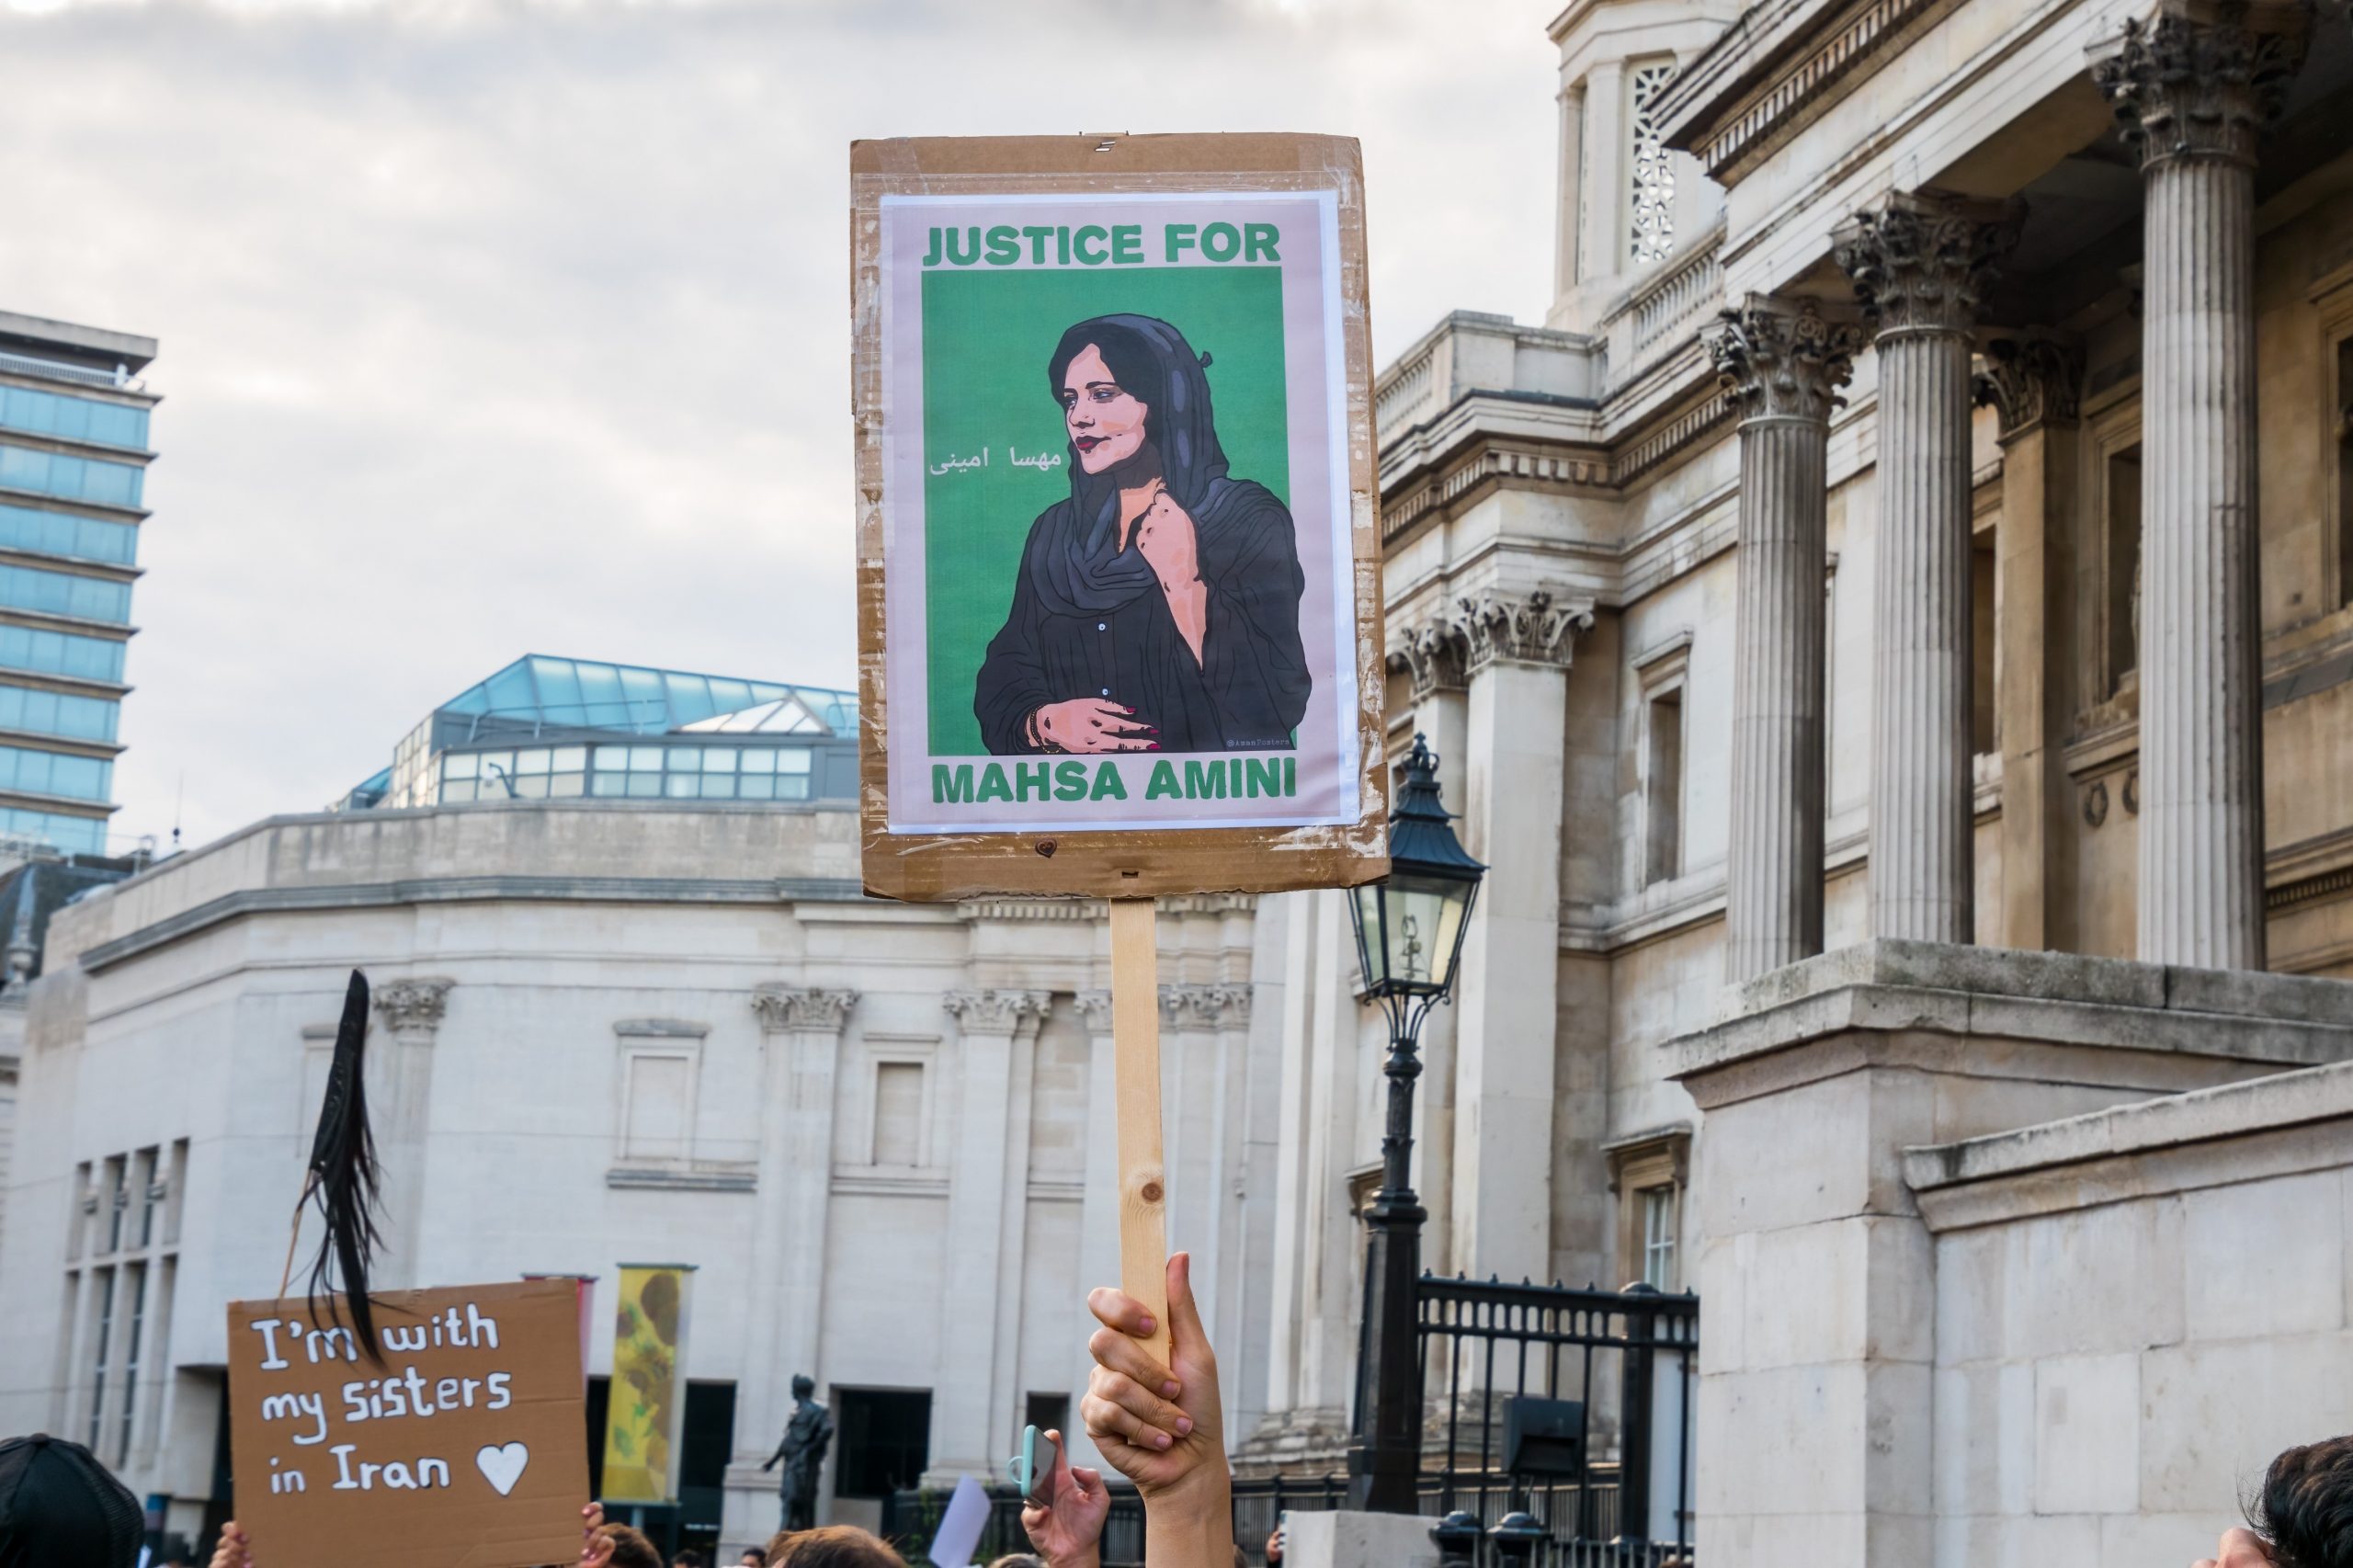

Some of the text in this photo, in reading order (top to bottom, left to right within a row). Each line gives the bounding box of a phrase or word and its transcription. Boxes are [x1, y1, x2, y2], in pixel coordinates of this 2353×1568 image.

[923, 222, 1281, 267] JUSTICE FOR
[930, 447, 1062, 475] مهسا امینی
[932, 756, 1297, 803] MAHSA AMINI
[251, 1302, 499, 1370] I'm with
[262, 1366, 512, 1445] my sisters
[270, 1444, 450, 1494] in Iran
